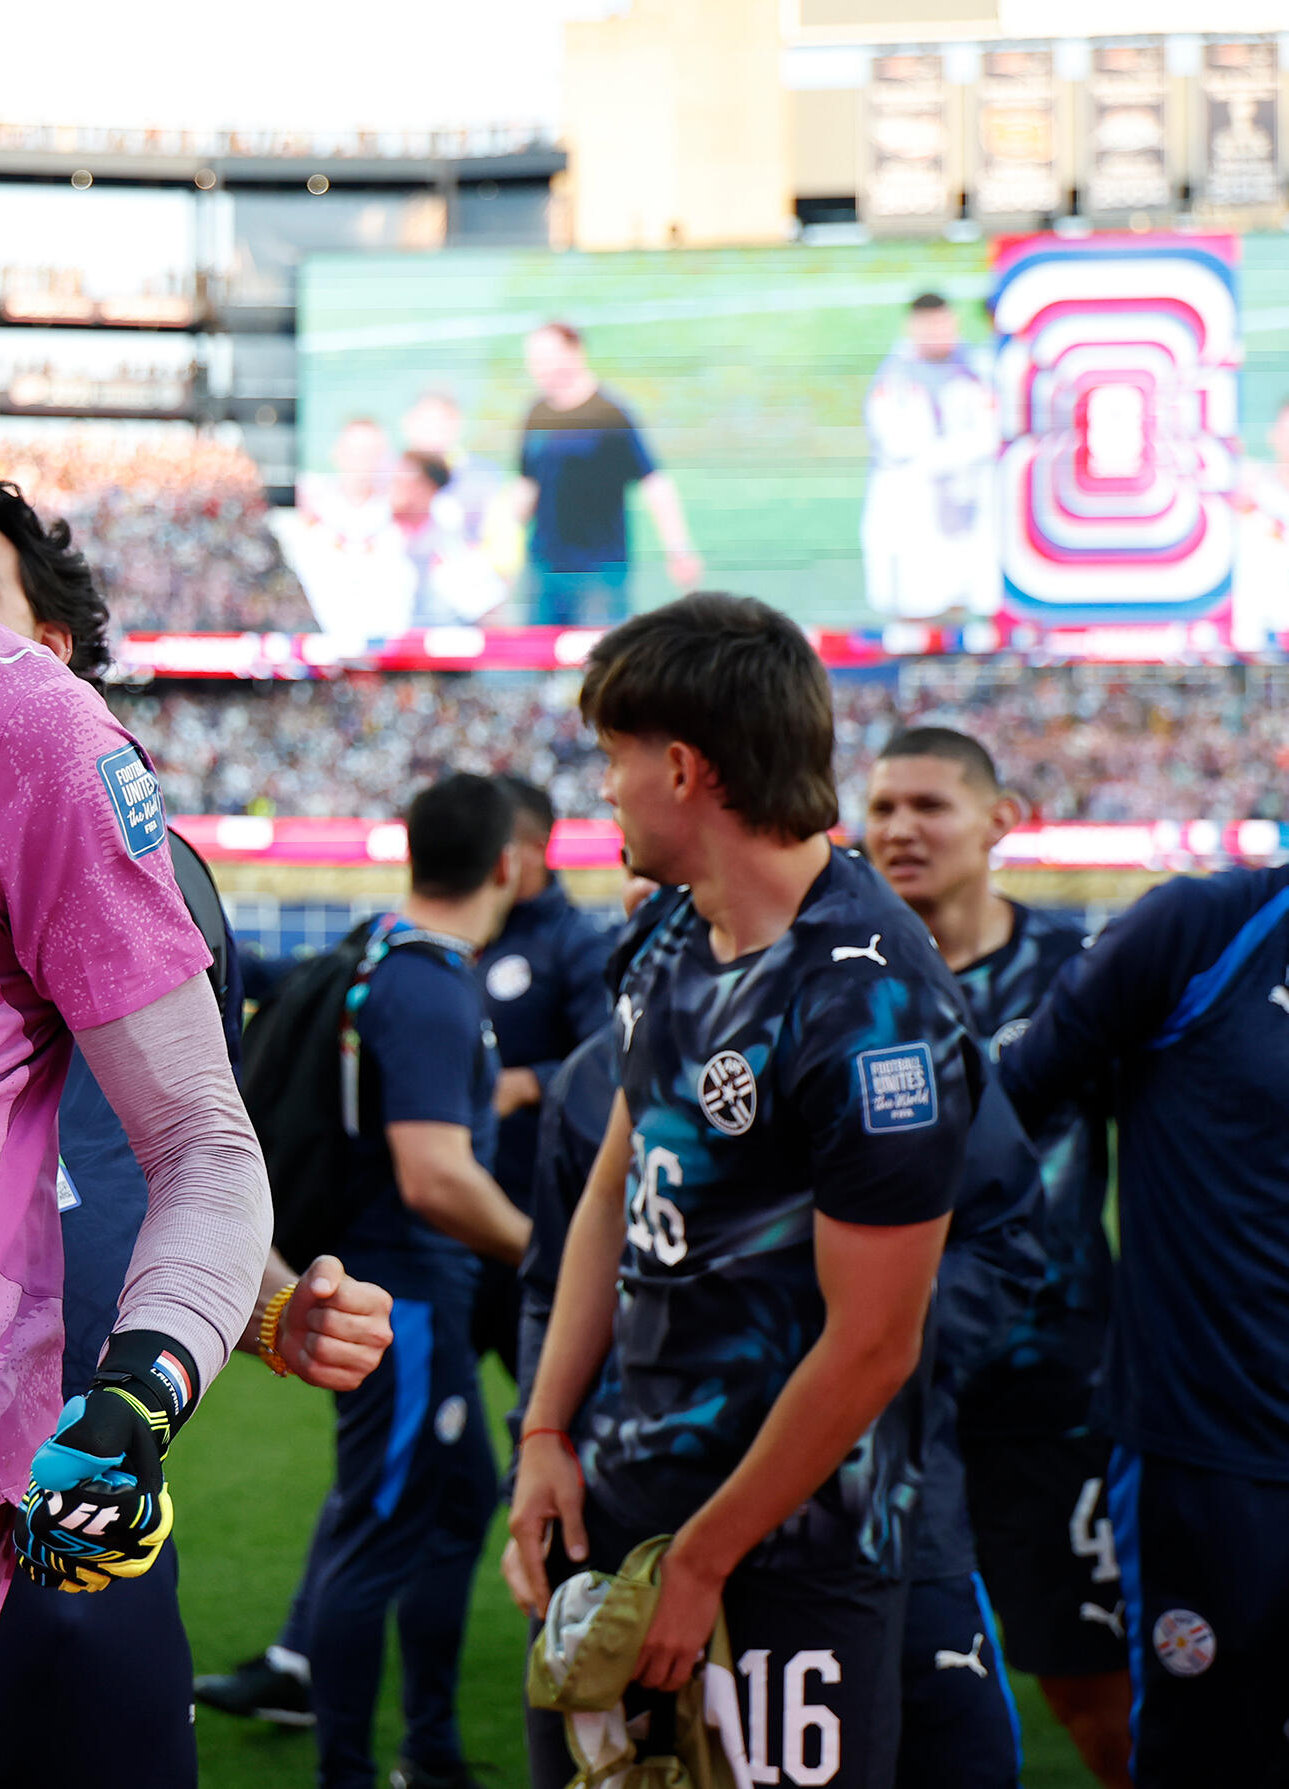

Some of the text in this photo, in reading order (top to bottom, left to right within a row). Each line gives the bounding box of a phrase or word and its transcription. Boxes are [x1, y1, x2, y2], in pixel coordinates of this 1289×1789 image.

[127, 806, 145, 828] the
[873, 1069, 925, 1095] UNITES
[737, 1649, 842, 1787] 16
